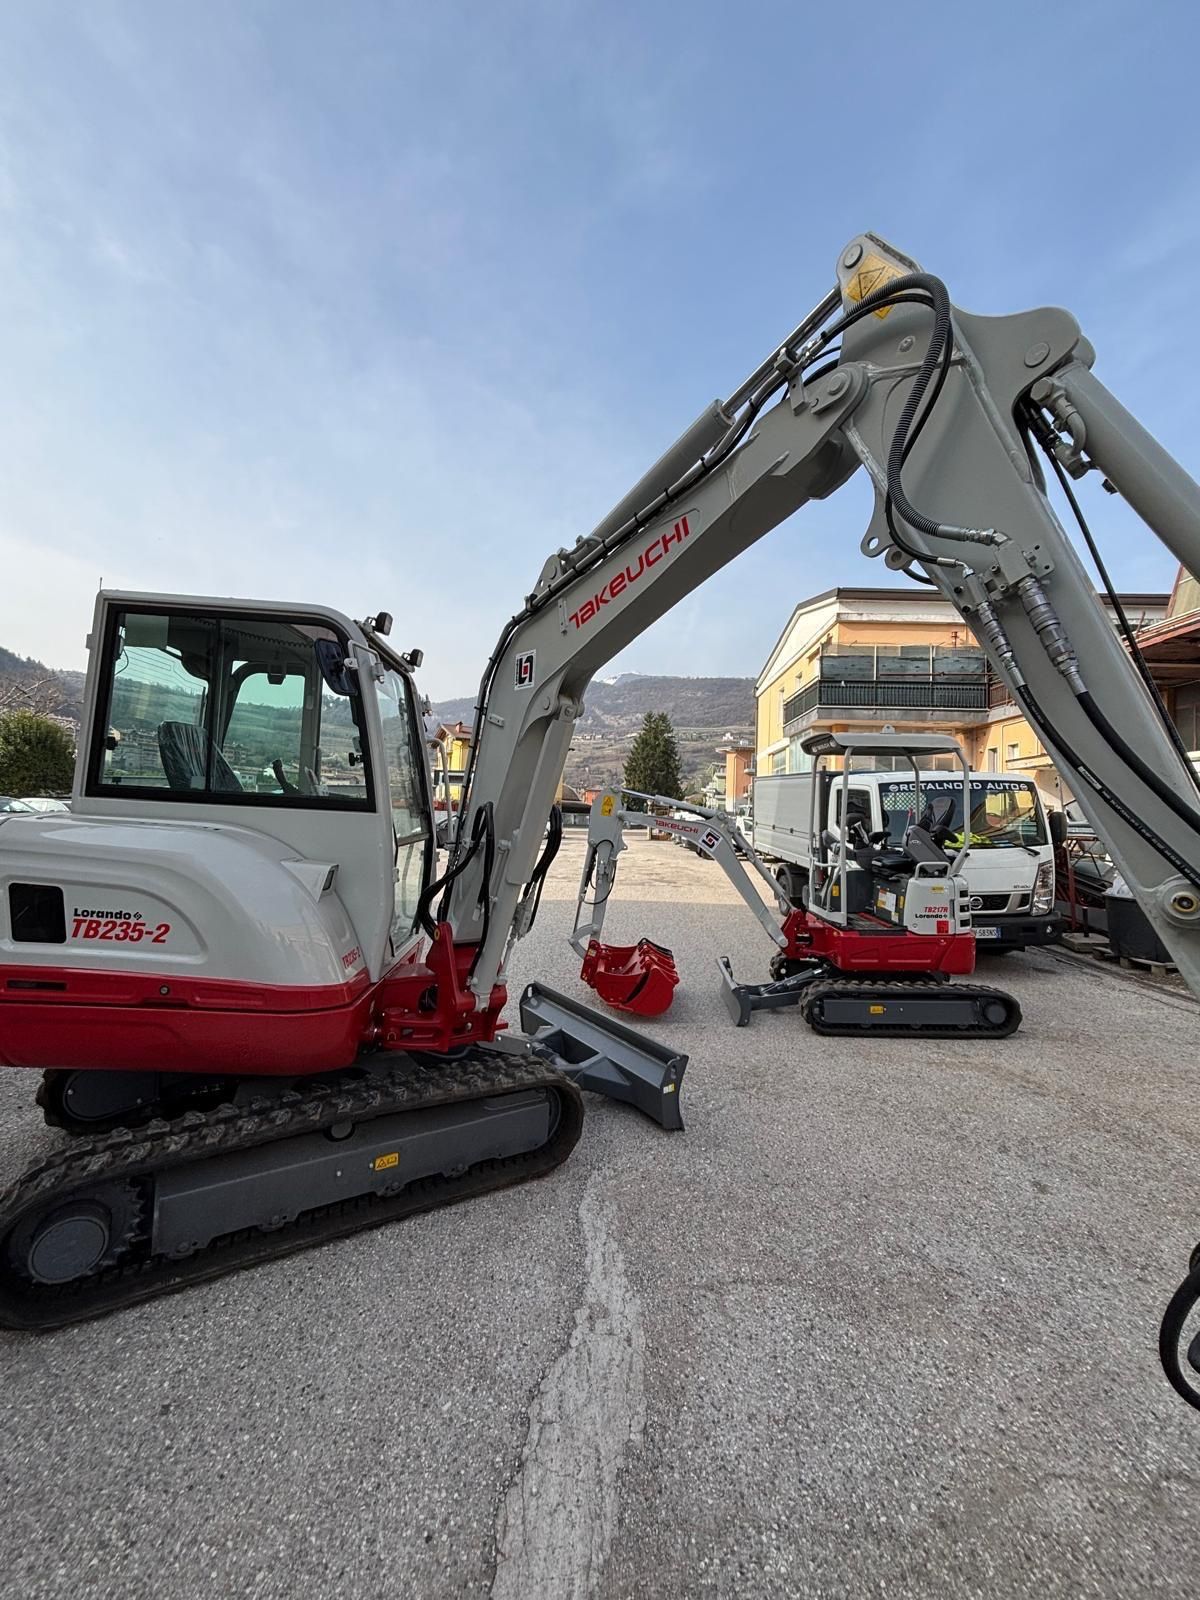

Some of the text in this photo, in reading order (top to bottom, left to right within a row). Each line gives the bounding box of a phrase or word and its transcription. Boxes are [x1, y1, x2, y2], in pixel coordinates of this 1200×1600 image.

[986, 782, 1019, 790] AUTO
[74, 908, 132, 920] Lorando
[71, 918, 171, 944] TB235-2
